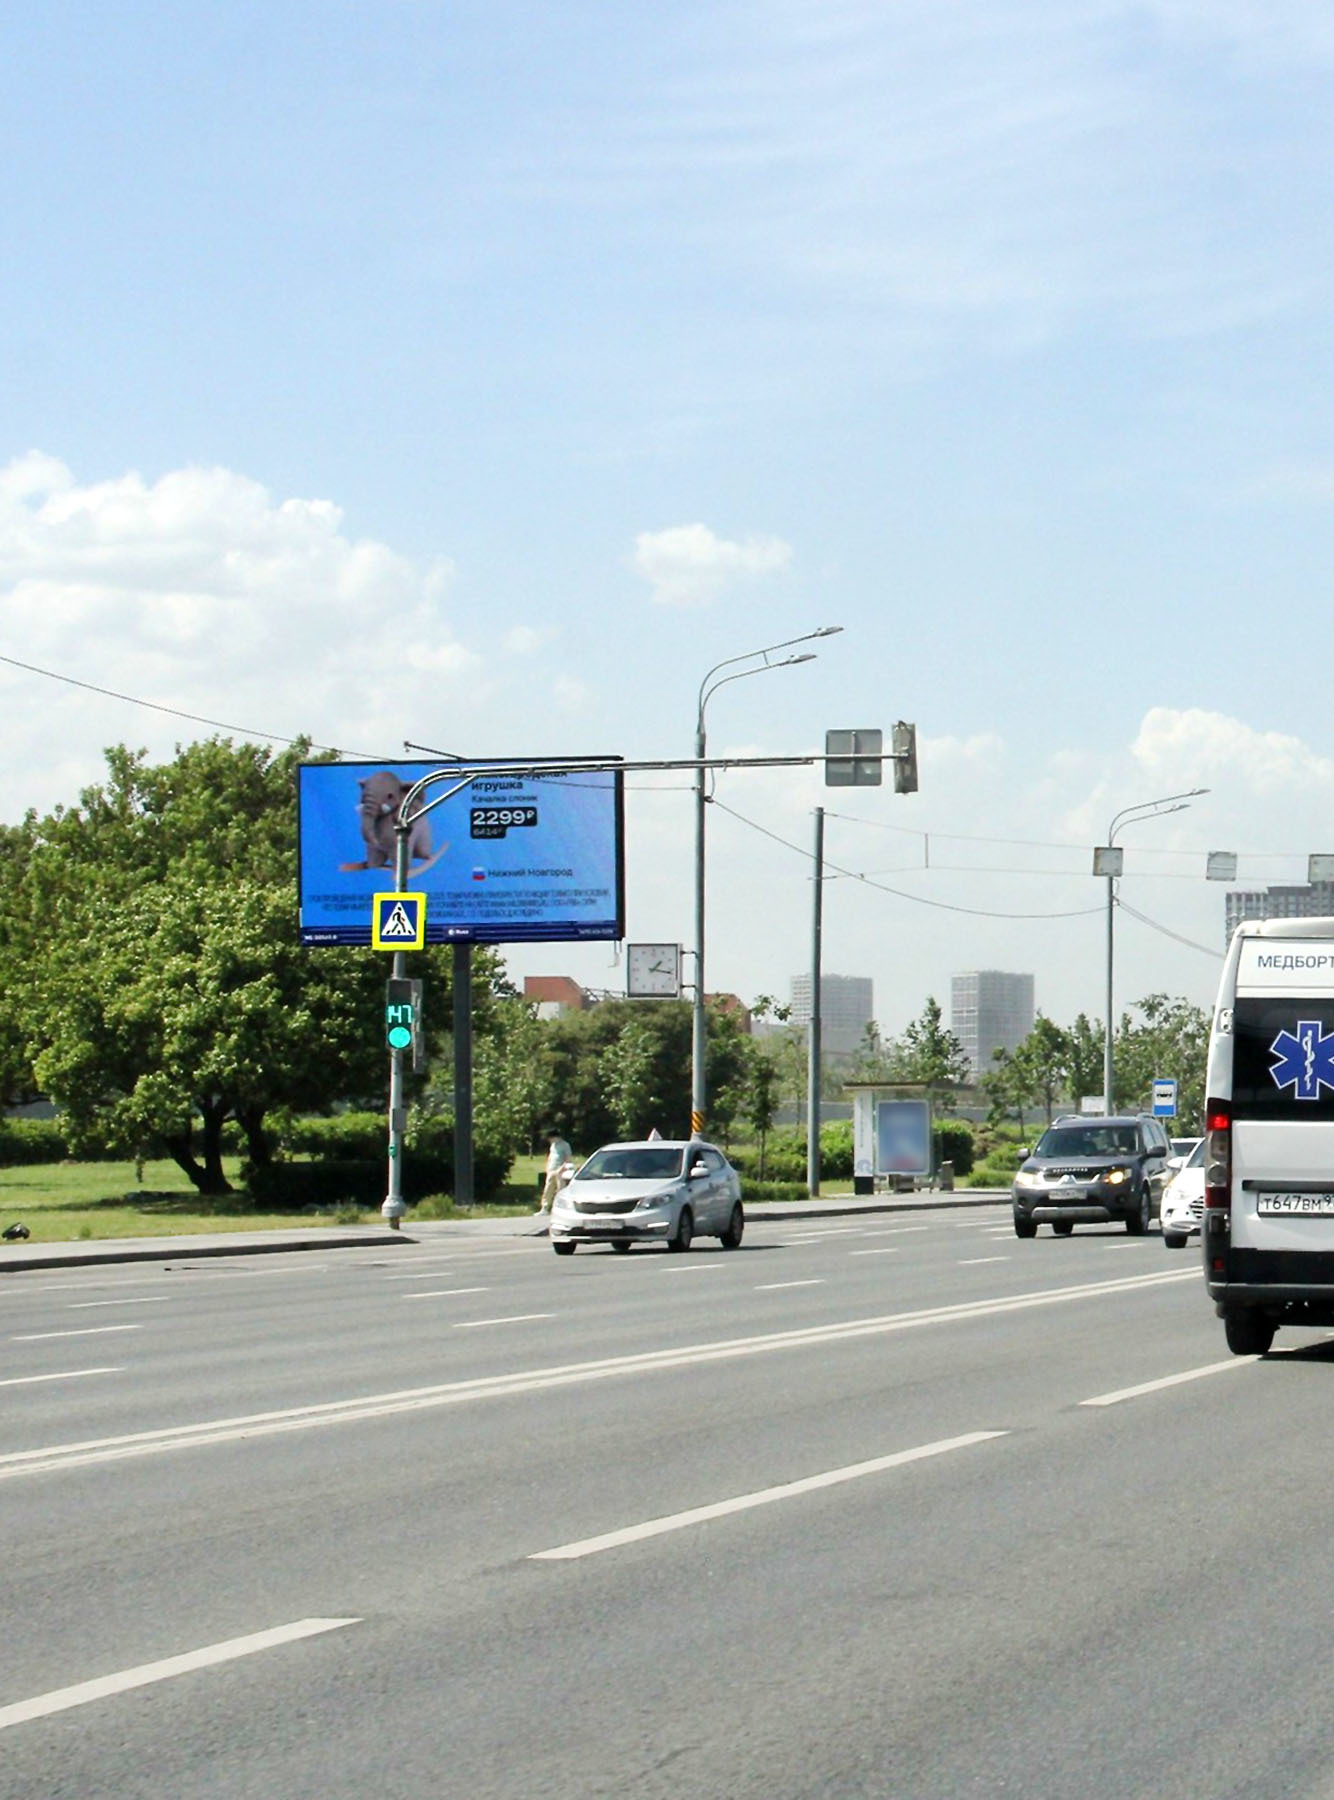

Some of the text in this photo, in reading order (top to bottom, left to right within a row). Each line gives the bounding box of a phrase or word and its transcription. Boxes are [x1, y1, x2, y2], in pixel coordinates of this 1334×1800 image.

[471, 782, 523, 792] игрушка
[488, 868, 573, 877] Нижний Новгород
